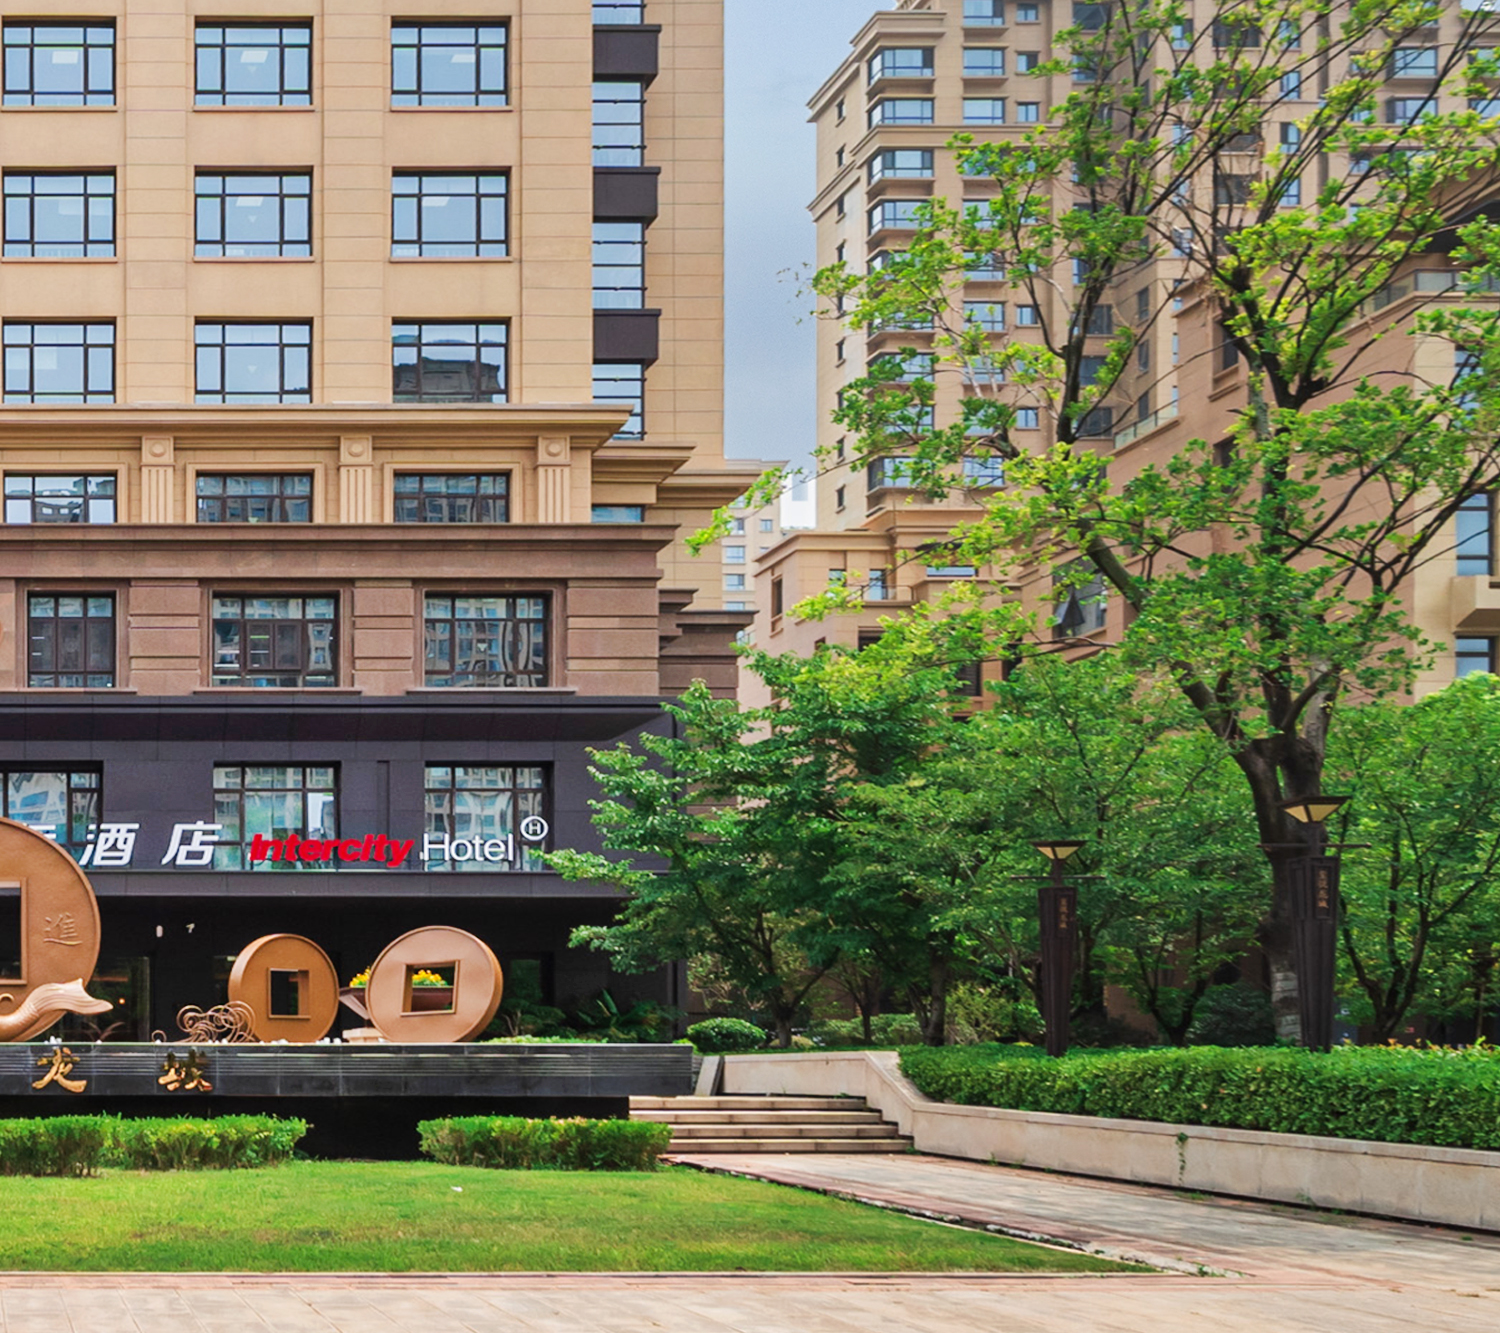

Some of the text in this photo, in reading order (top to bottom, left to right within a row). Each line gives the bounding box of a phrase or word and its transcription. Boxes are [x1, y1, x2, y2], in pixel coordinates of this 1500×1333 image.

[249, 833, 415, 868] Intercity
[423, 833, 514, 861] Hotel
[43, 912, 82, 946] 進
